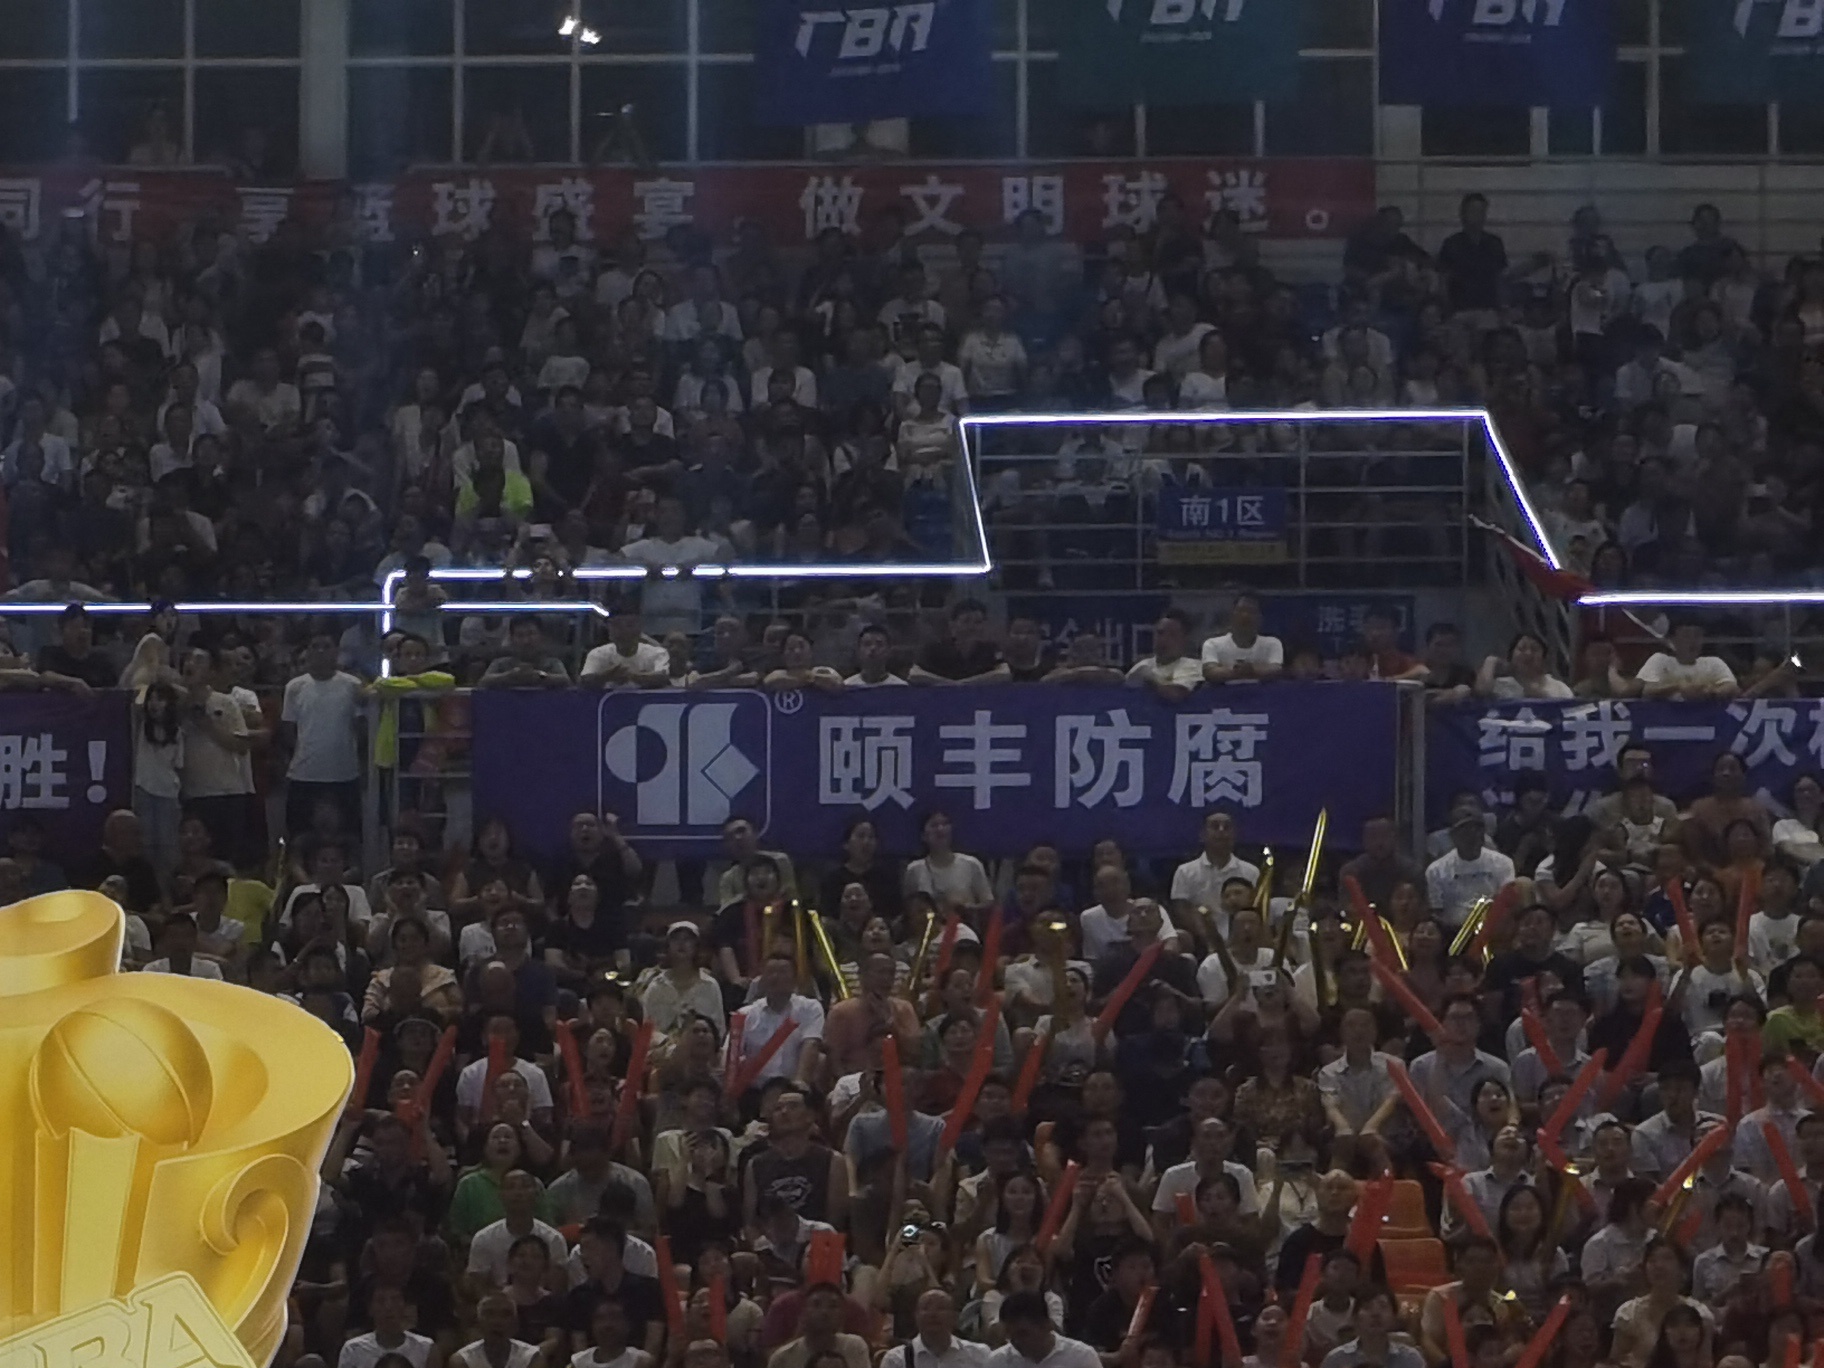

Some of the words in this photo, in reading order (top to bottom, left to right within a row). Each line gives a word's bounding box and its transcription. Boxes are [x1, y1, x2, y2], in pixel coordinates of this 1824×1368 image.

[1179, 495, 1264, 526] 南1区
[818, 708, 1269, 811] 颐丰防腐
[1478, 700, 1824, 771] 给我一次
